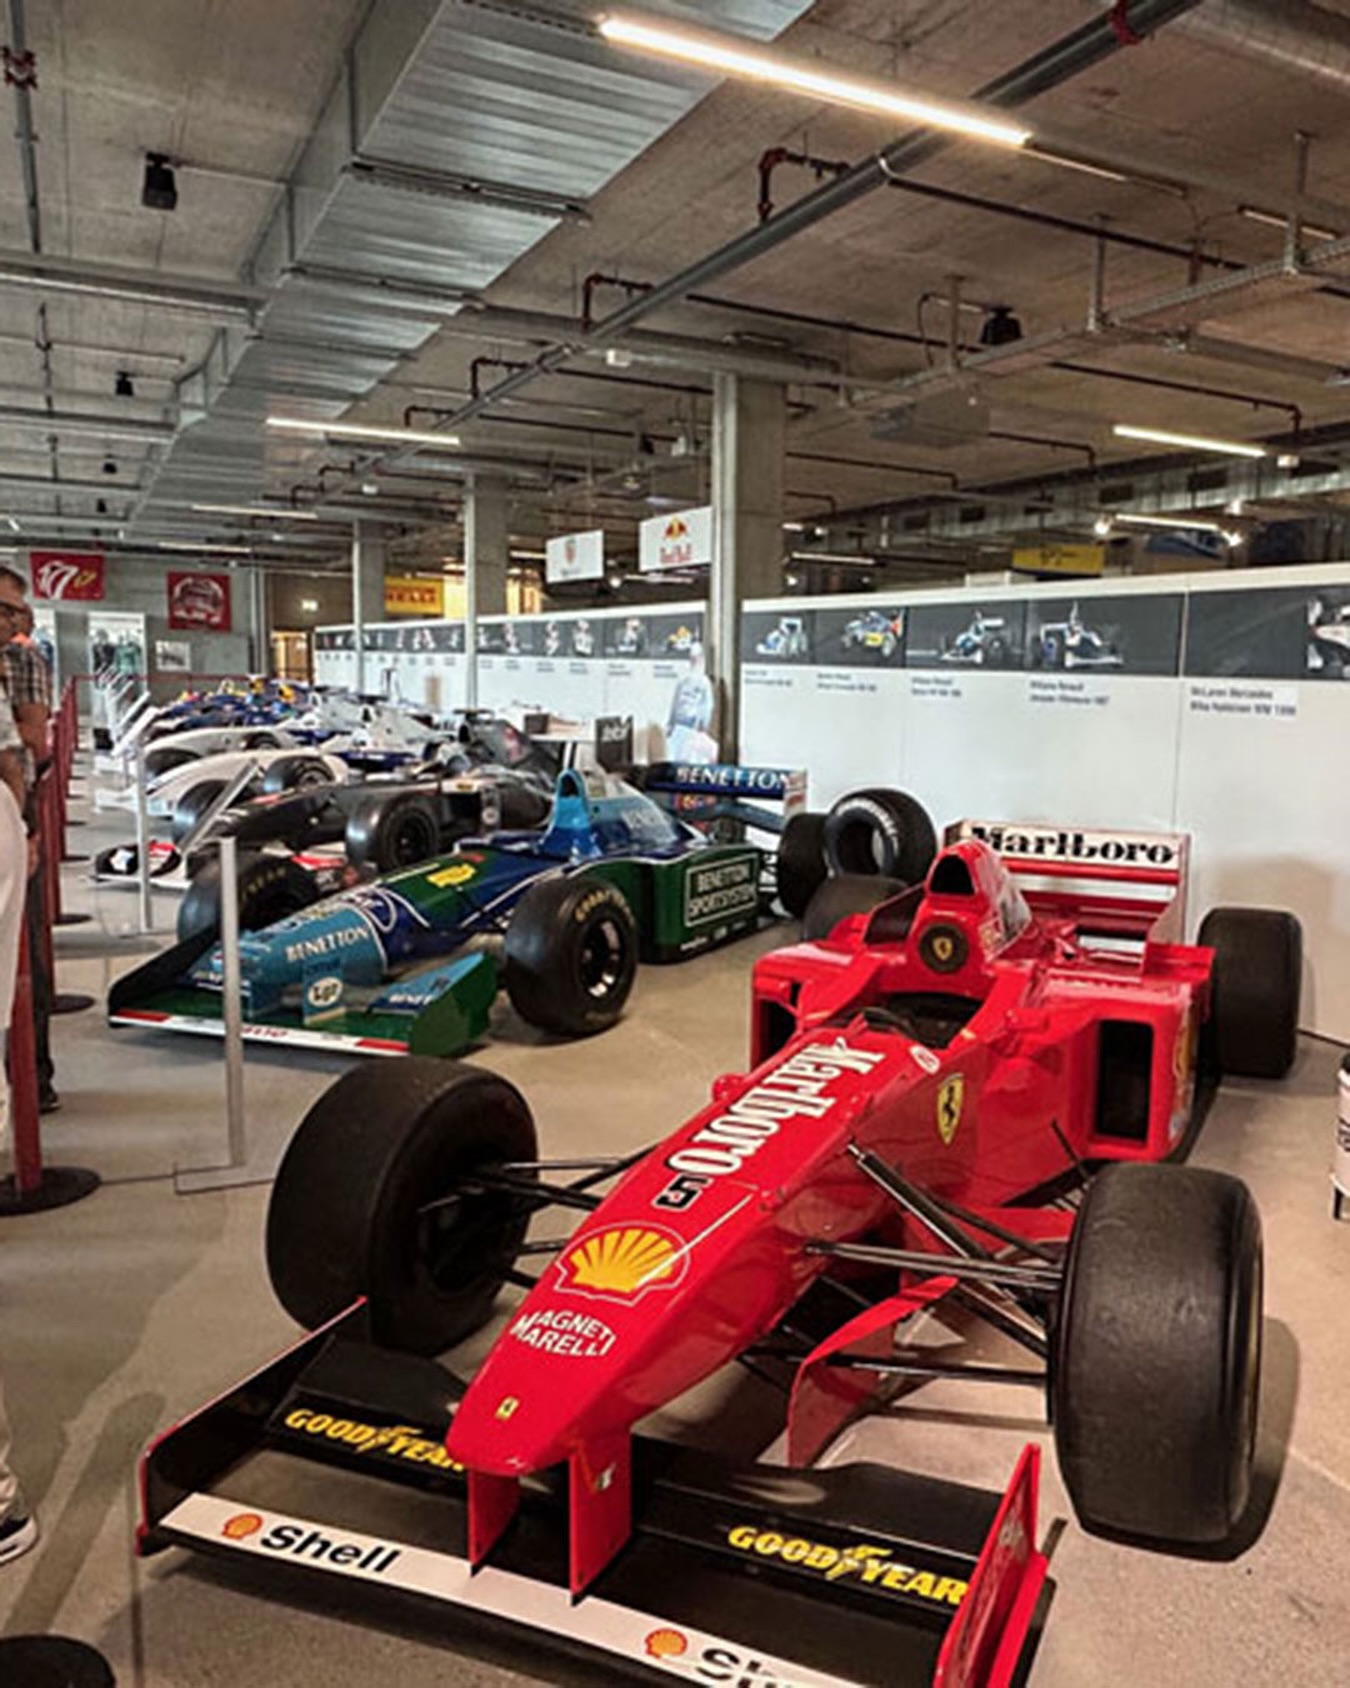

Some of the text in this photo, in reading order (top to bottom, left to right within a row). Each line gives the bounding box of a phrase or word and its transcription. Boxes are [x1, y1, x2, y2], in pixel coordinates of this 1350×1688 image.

[971, 826, 1175, 865] Marlboro
[285, 925, 368, 962] BENETTON
[667, 1037, 886, 1175] Marlboro
[285, 1408, 465, 1472] GOODYEA
[260, 1524, 401, 1573] Shell
[728, 1525, 969, 1606] GOODYEAR
